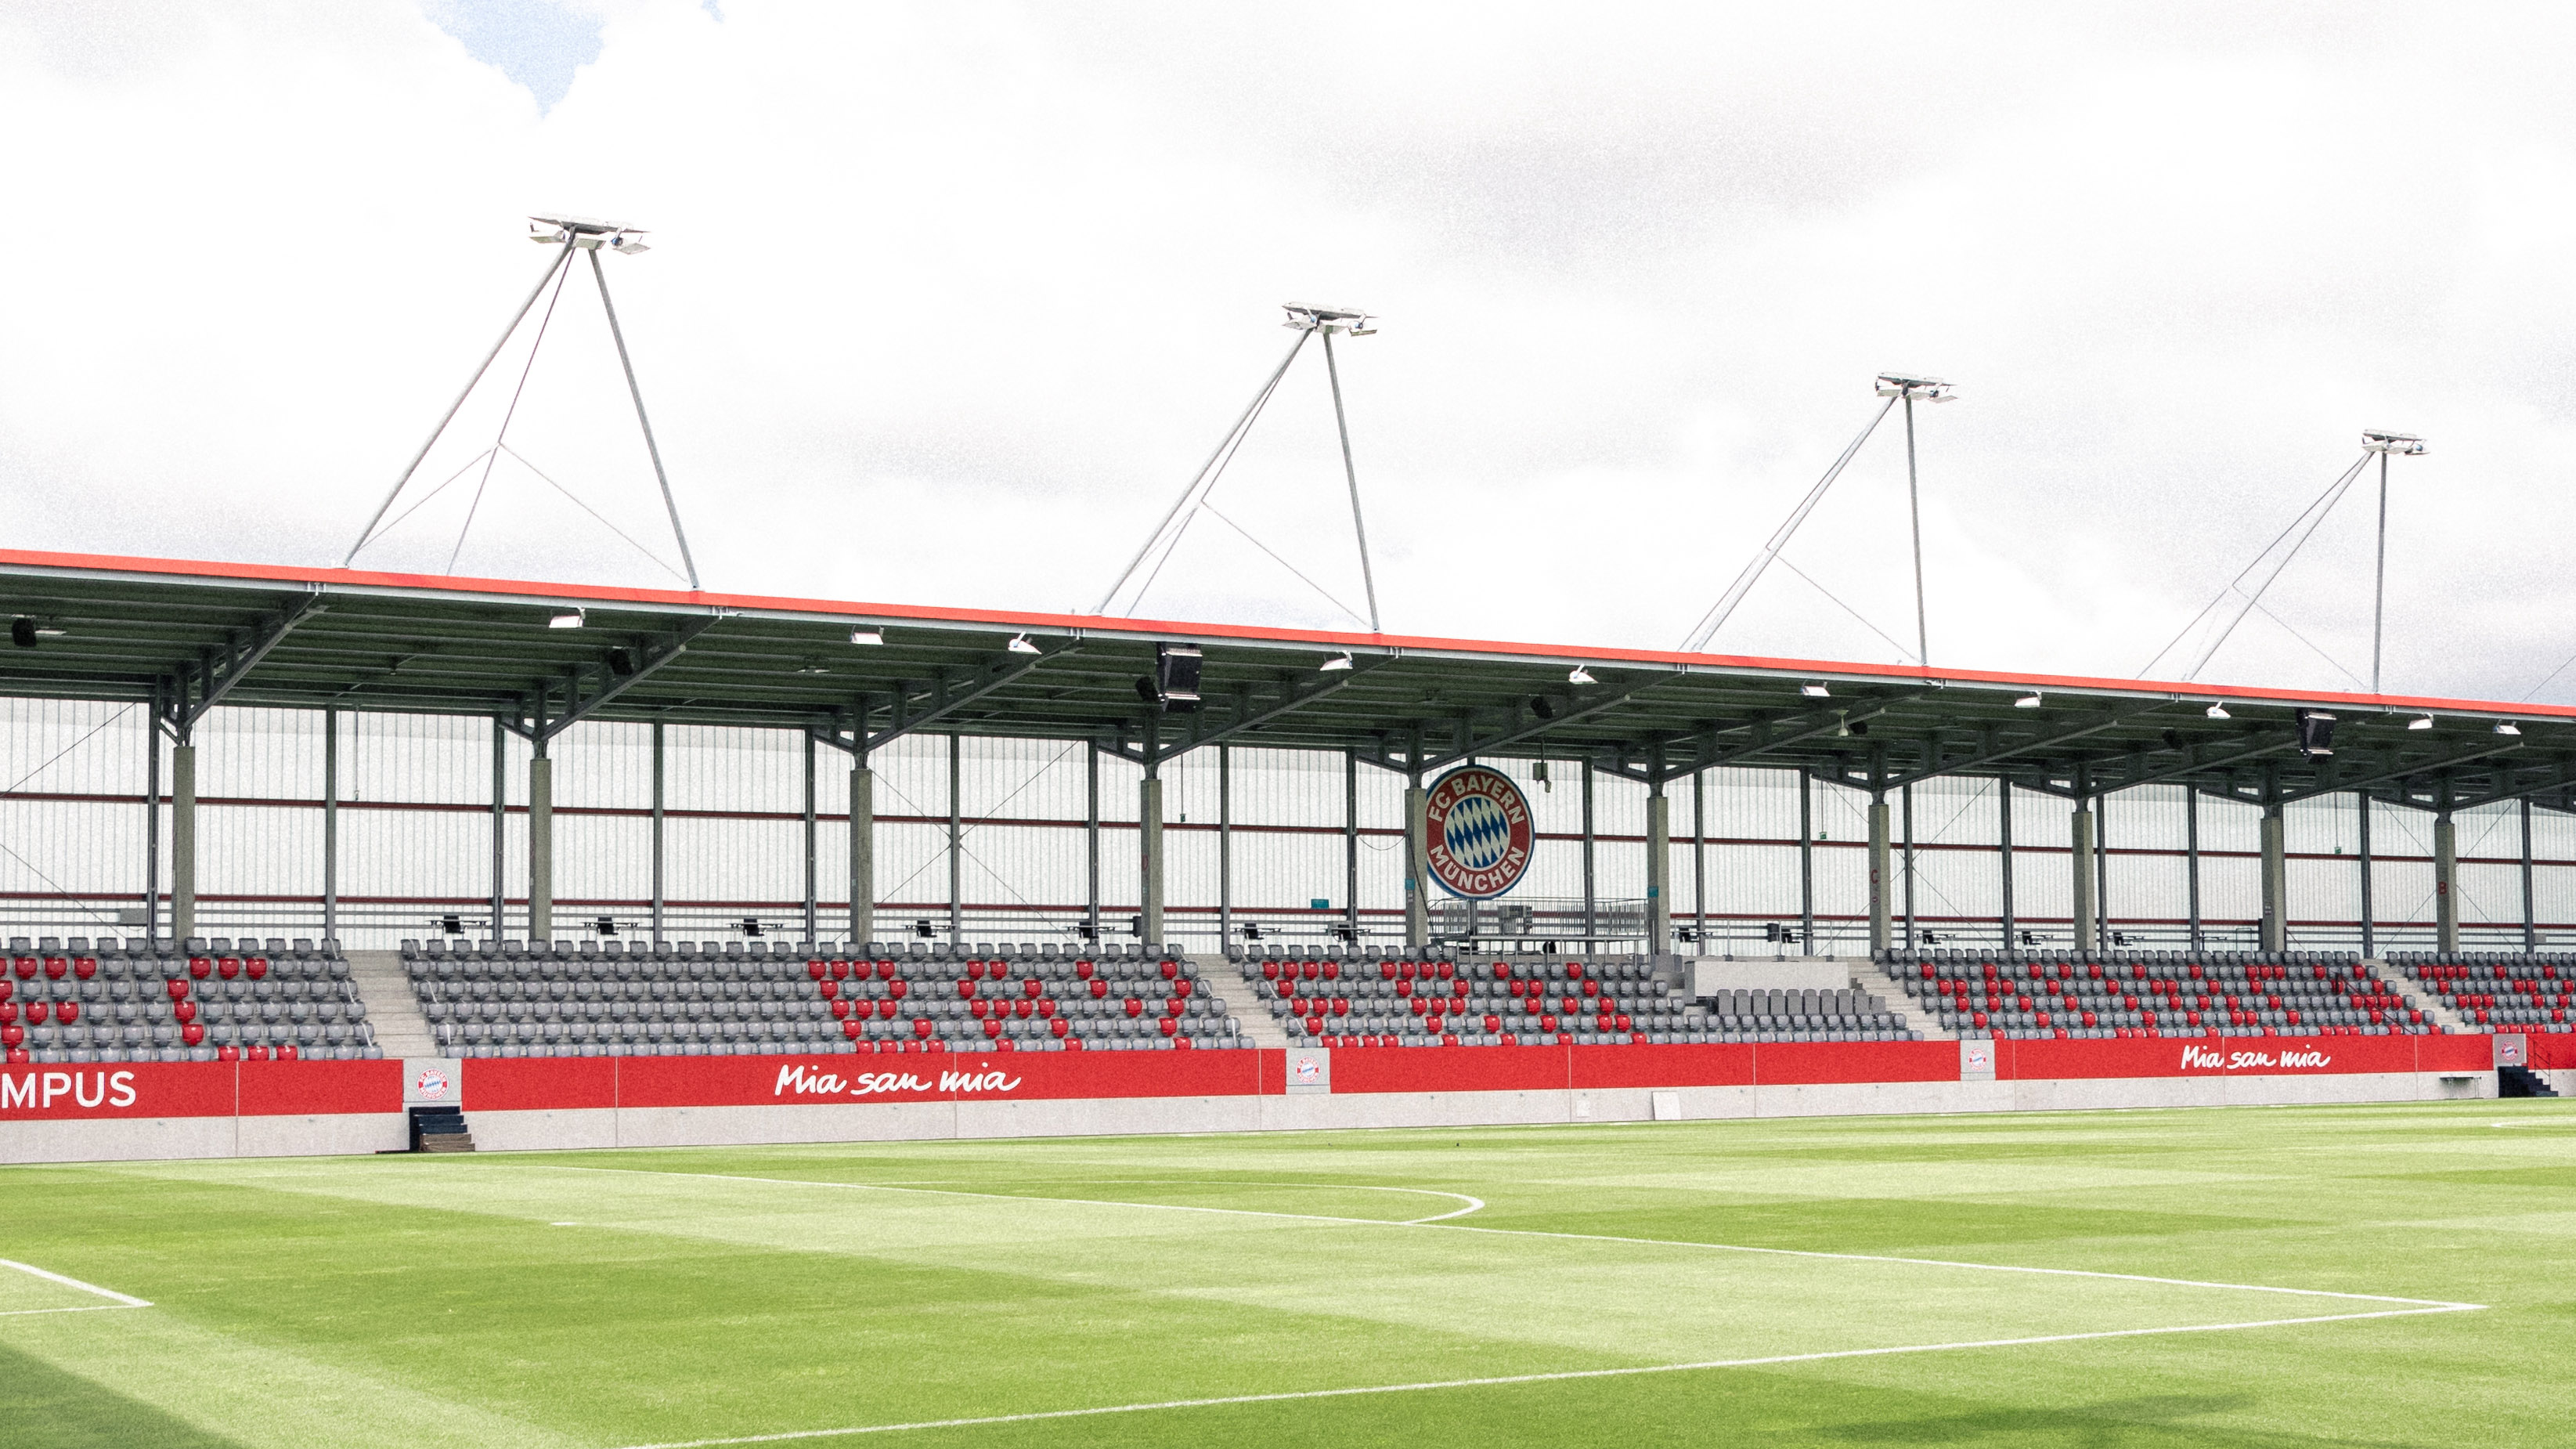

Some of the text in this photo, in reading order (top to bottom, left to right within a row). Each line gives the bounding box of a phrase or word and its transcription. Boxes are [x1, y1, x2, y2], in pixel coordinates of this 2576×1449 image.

[1428, 775, 1524, 824] FC BAYERN
[1430, 844, 1524, 891] MÜNCHEN
[2437, 880, 2448, 895] B
[2181, 1043, 2331, 1070] Mia san mia
[1, 1070, 136, 1109] MPUS
[774, 1062, 1021, 1096] Mia san mia
